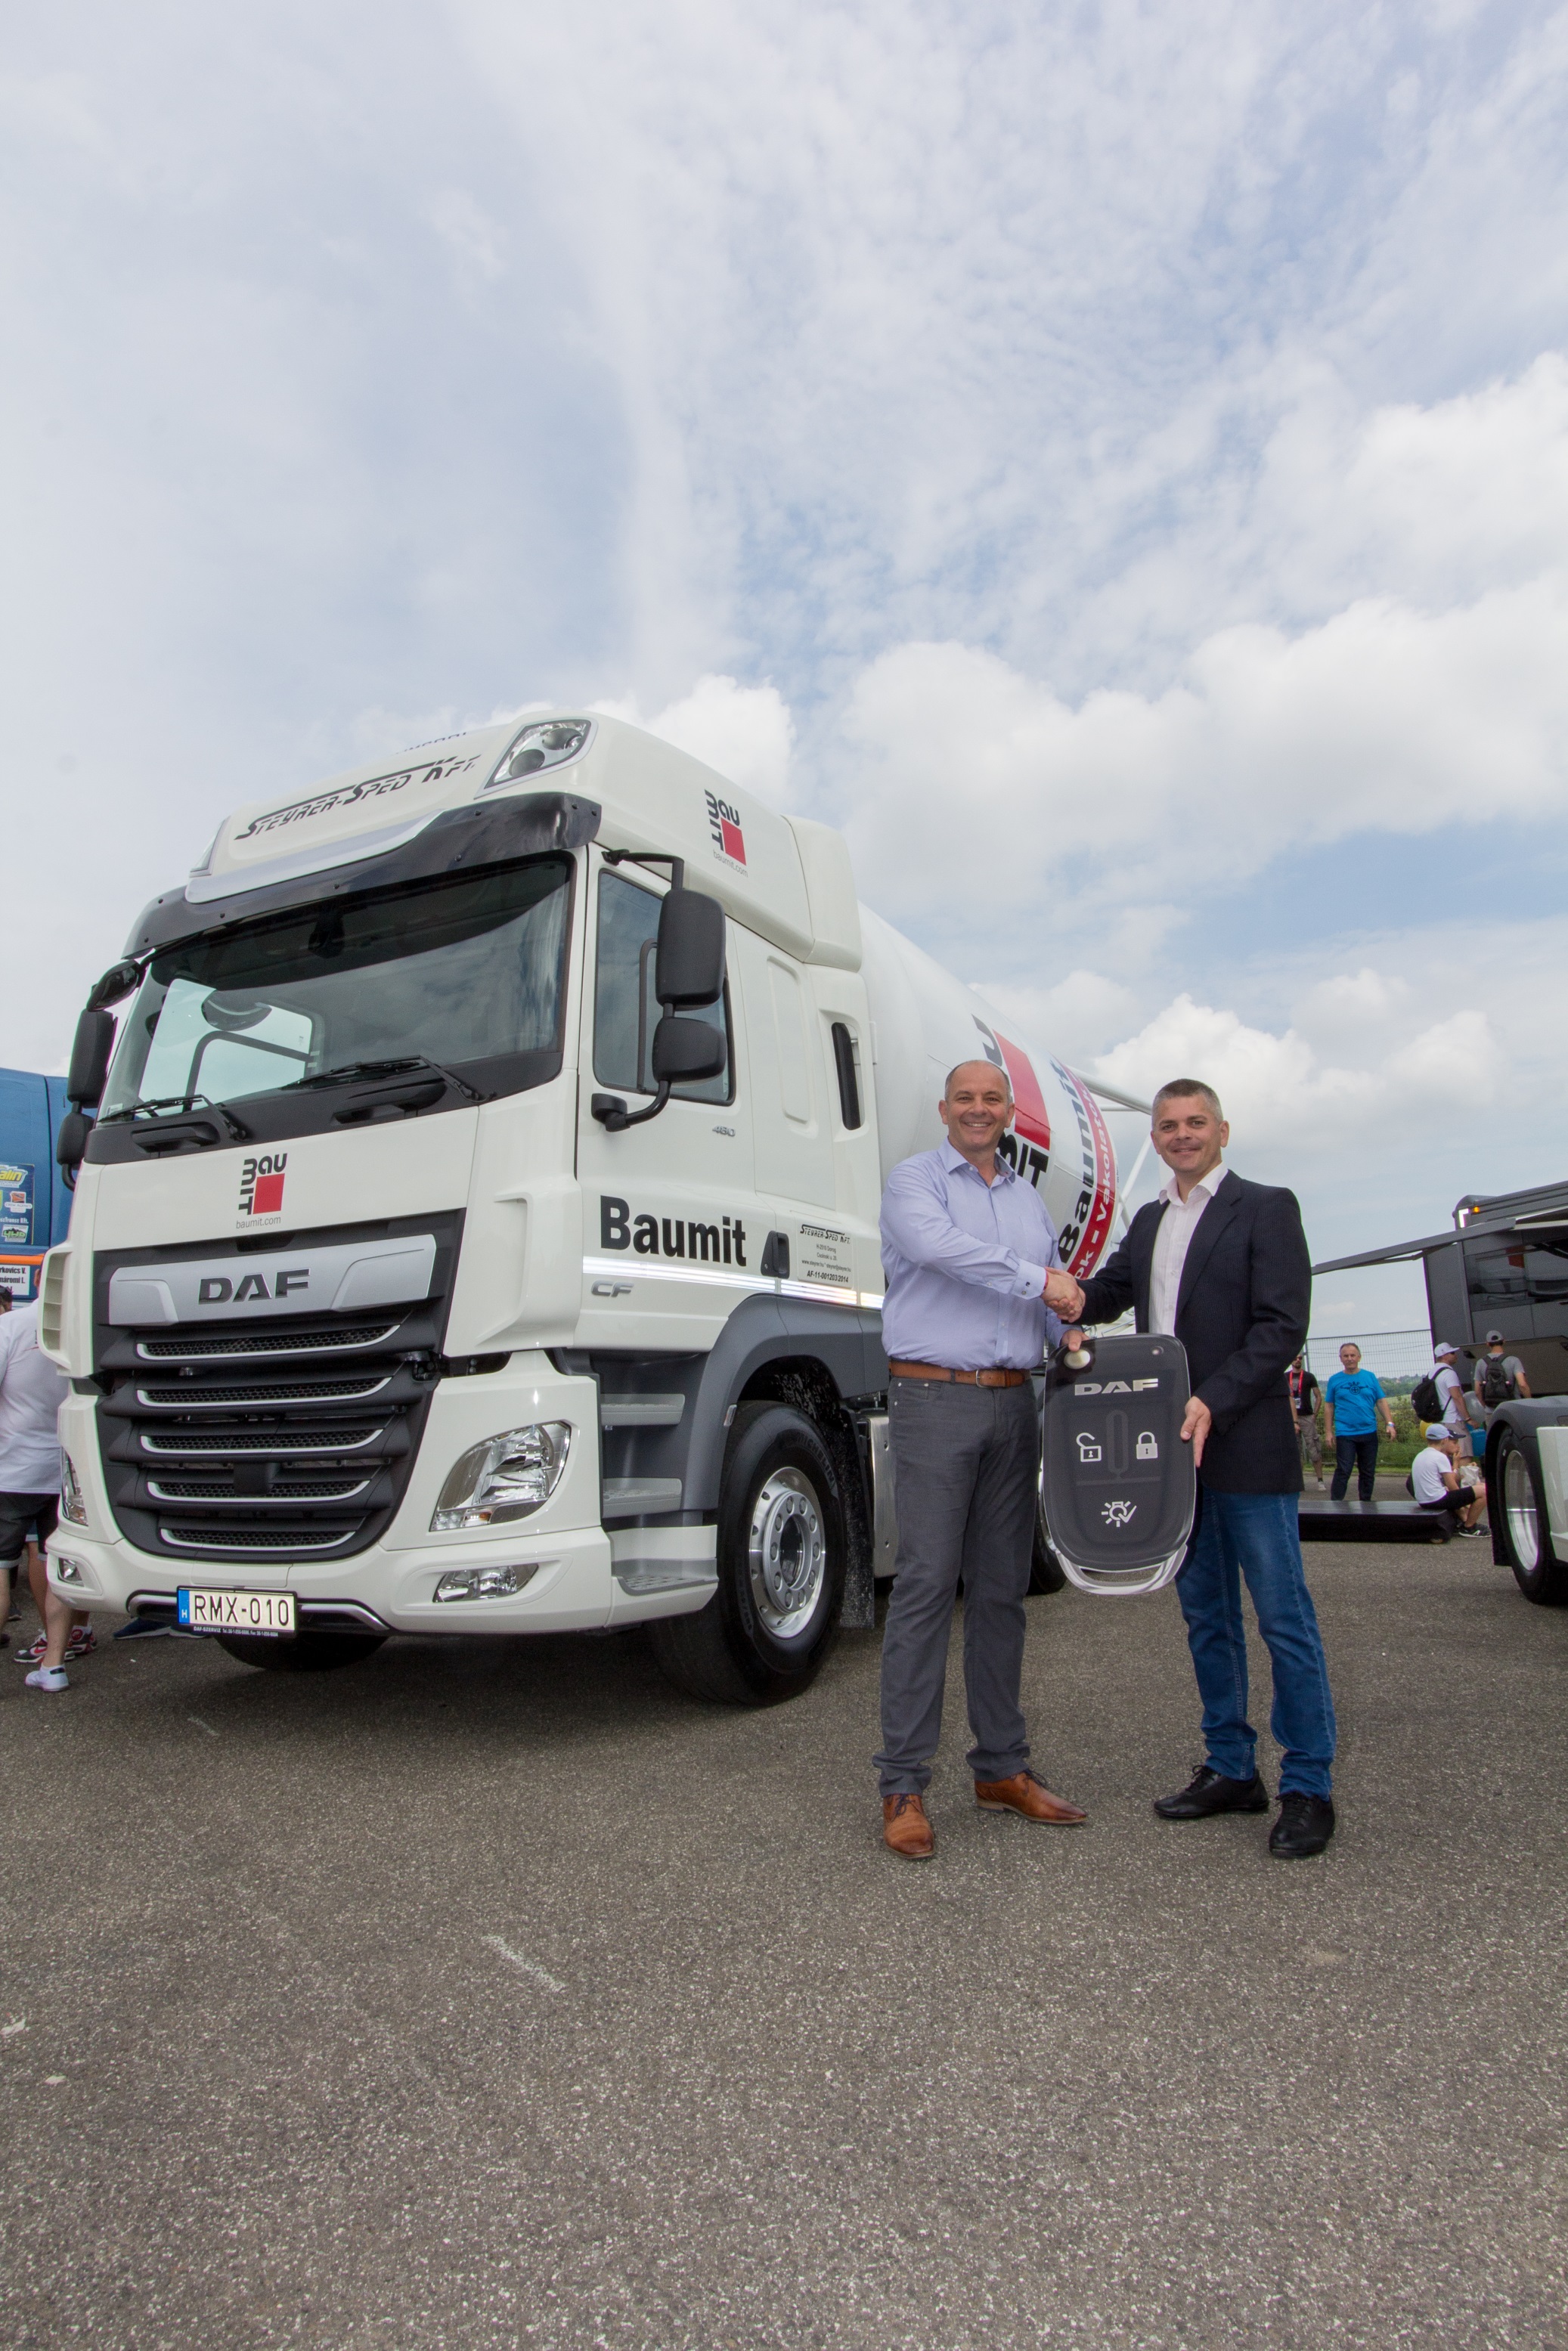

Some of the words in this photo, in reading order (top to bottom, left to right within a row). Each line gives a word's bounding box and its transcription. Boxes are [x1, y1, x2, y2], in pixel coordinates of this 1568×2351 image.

[713, 849, 748, 878] baumit.com
[1049, 1059, 1094, 1264] Baumit
[236, 1217, 281, 1229] baumit.com
[600, 1195, 747, 1267] Baumit
[198, 1268, 311, 1305] DAF
[591, 1280, 634, 1297] CF
[1074, 1378, 1159, 1395] DAF
[181, 1609, 187, 1618] H
[194, 1595, 289, 1626] RMX-010
